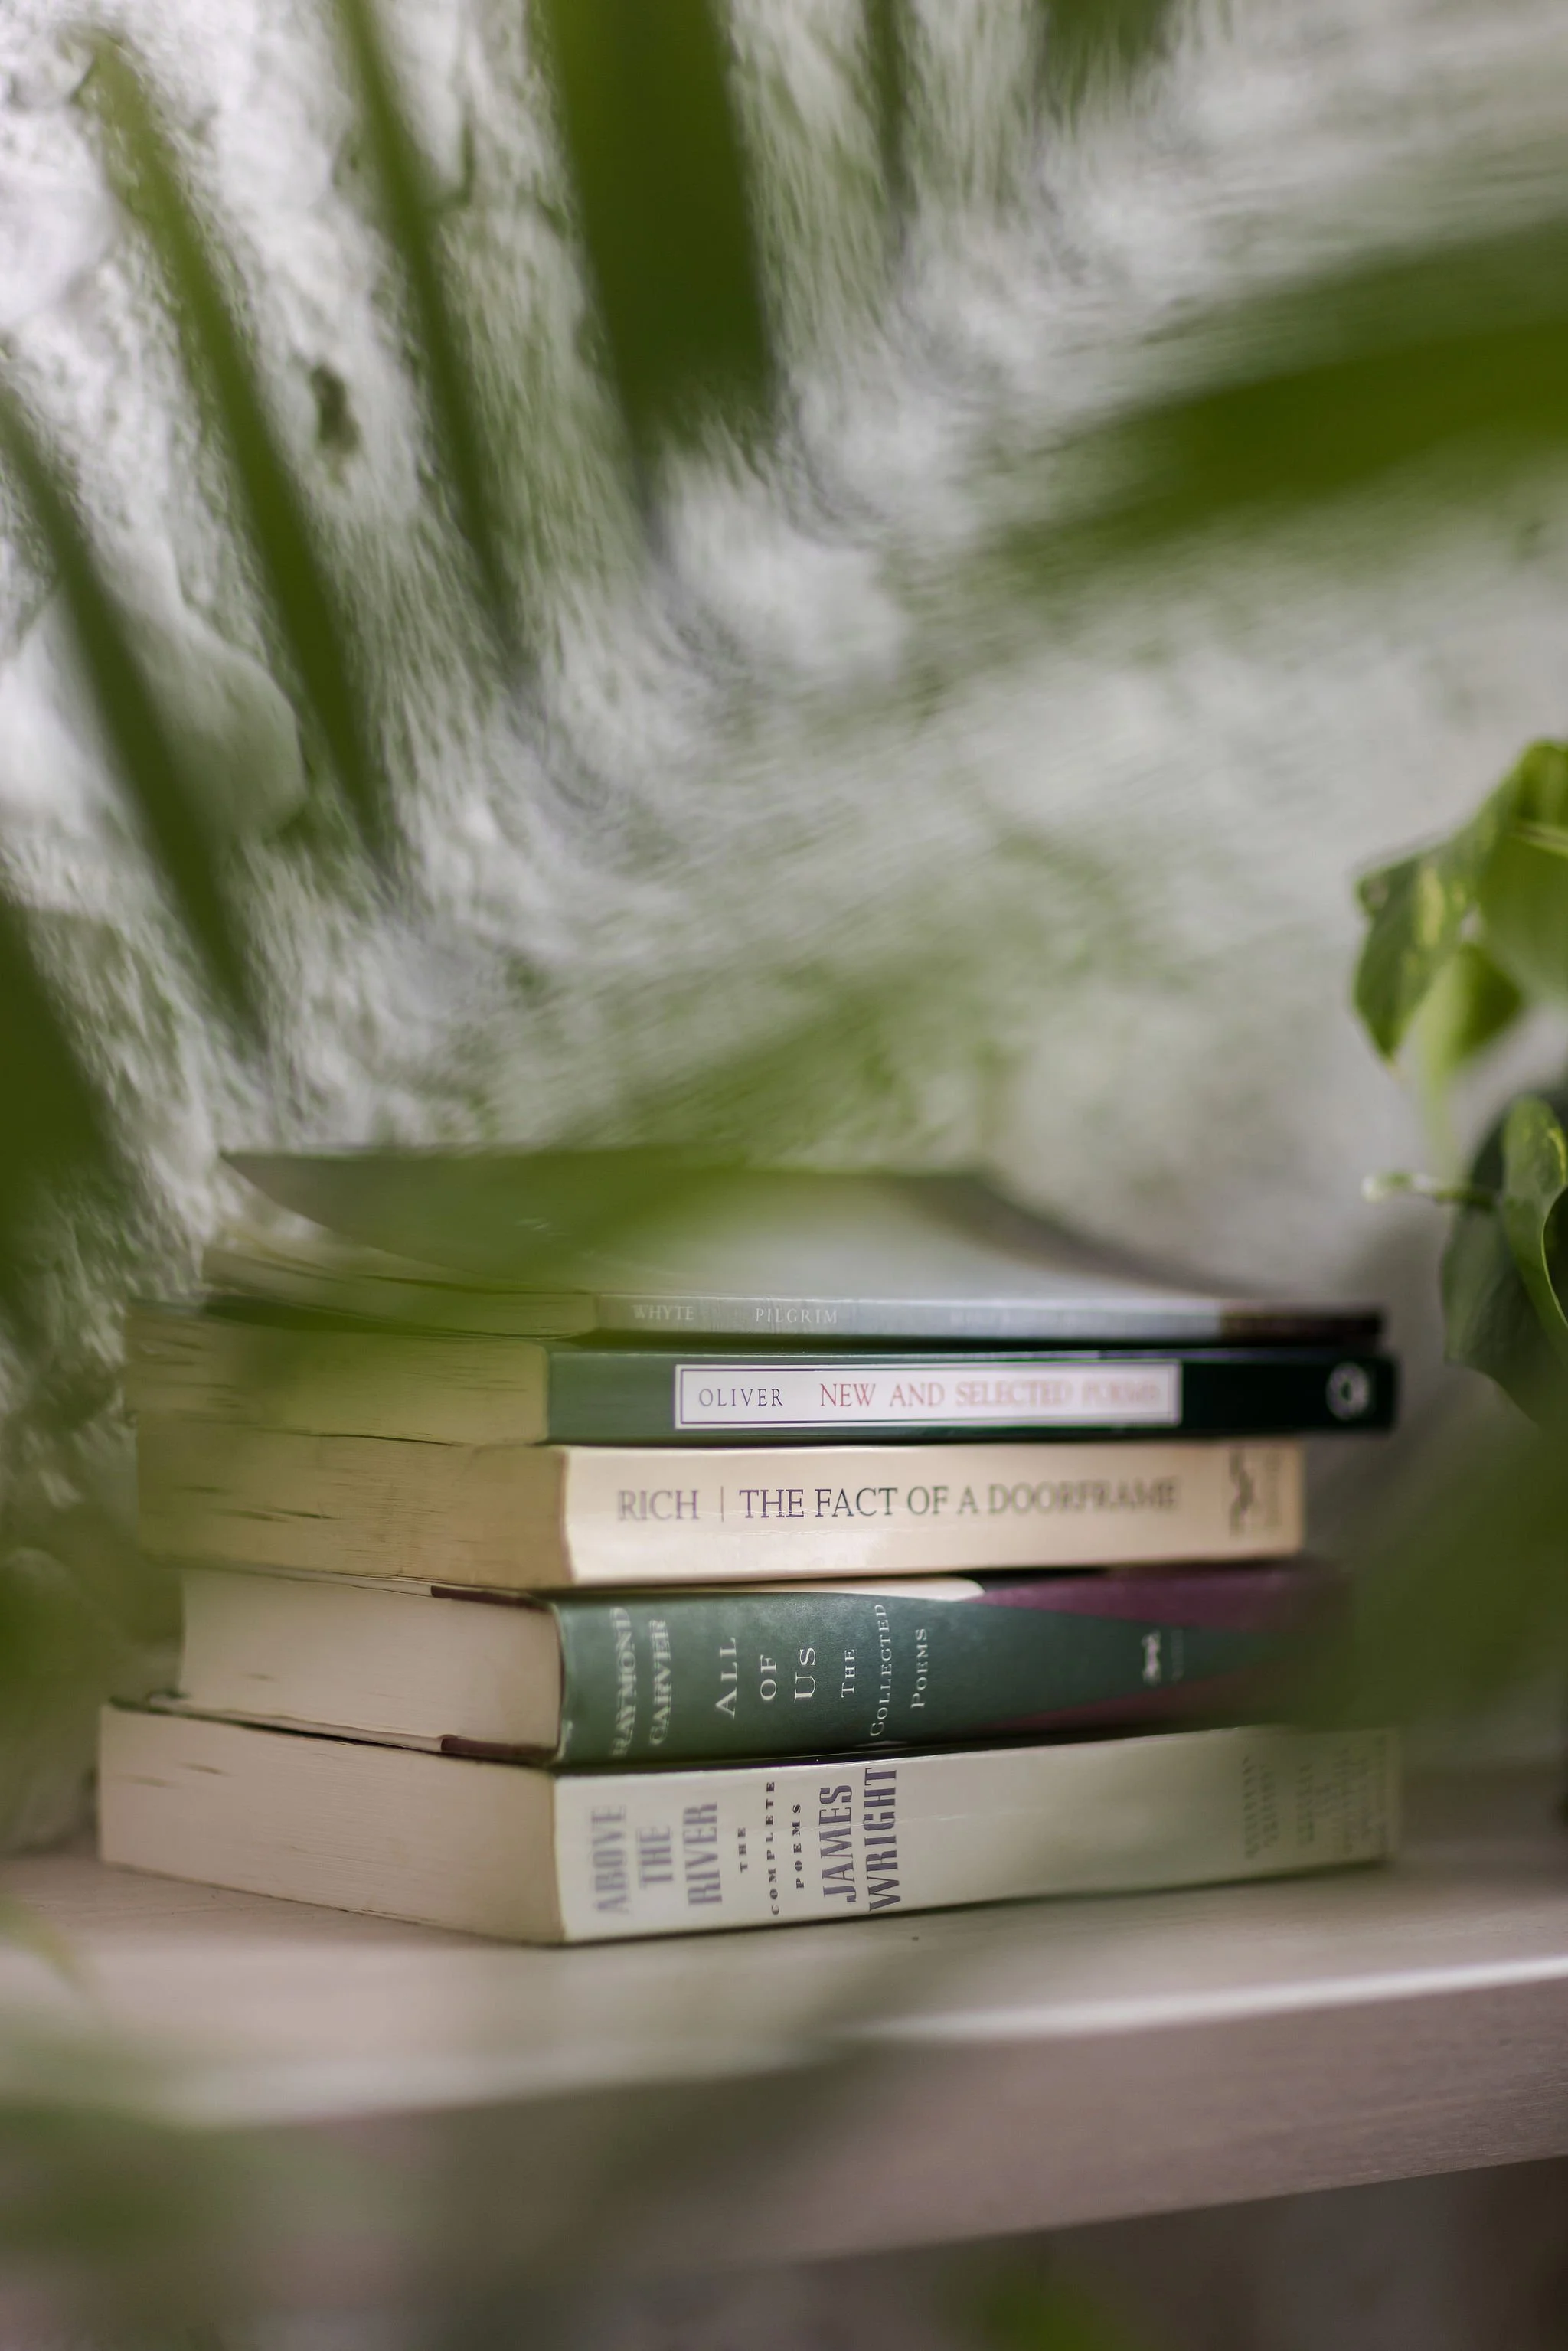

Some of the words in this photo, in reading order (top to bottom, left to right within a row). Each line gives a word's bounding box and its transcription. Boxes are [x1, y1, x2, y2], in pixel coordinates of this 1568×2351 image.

[633, 1304, 695, 1322] WHYTE
[756, 1308, 838, 1324] PILGRIM
[698, 1387, 784, 1407] OLIVER
[820, 1383, 877, 1407] NEW
[890, 1382, 945, 1406] AND
[956, 1380, 1074, 1407] SELECTED
[616, 1489, 700, 1521] RICH
[739, 1488, 805, 1519] THE
[815, 1487, 898, 1517] FACT
[907, 1485, 949, 1515] OF
[956, 1486, 981, 1515] A
[610, 1606, 637, 1756] RAYMOND
[648, 1619, 672, 1746] CARVER
[716, 1637, 739, 1720] ALL
[760, 1654, 778, 1701] OF
[841, 1648, 856, 1698] THE
[870, 1604, 893, 1736] COLLECTED
[911, 1628, 928, 1709] POEMS
[591, 1804, 630, 1914] ABOVE
[638, 1824, 675, 1888] THE
[684, 1802, 723, 1905] RIVER
[737, 1827, 749, 1873] THE
[766, 1781, 780, 1915] COMPLETE
[792, 1804, 805, 1889] POEMS
[819, 1784, 857, 1903] JAMES
[863, 1767, 902, 1912] WRIGHT
